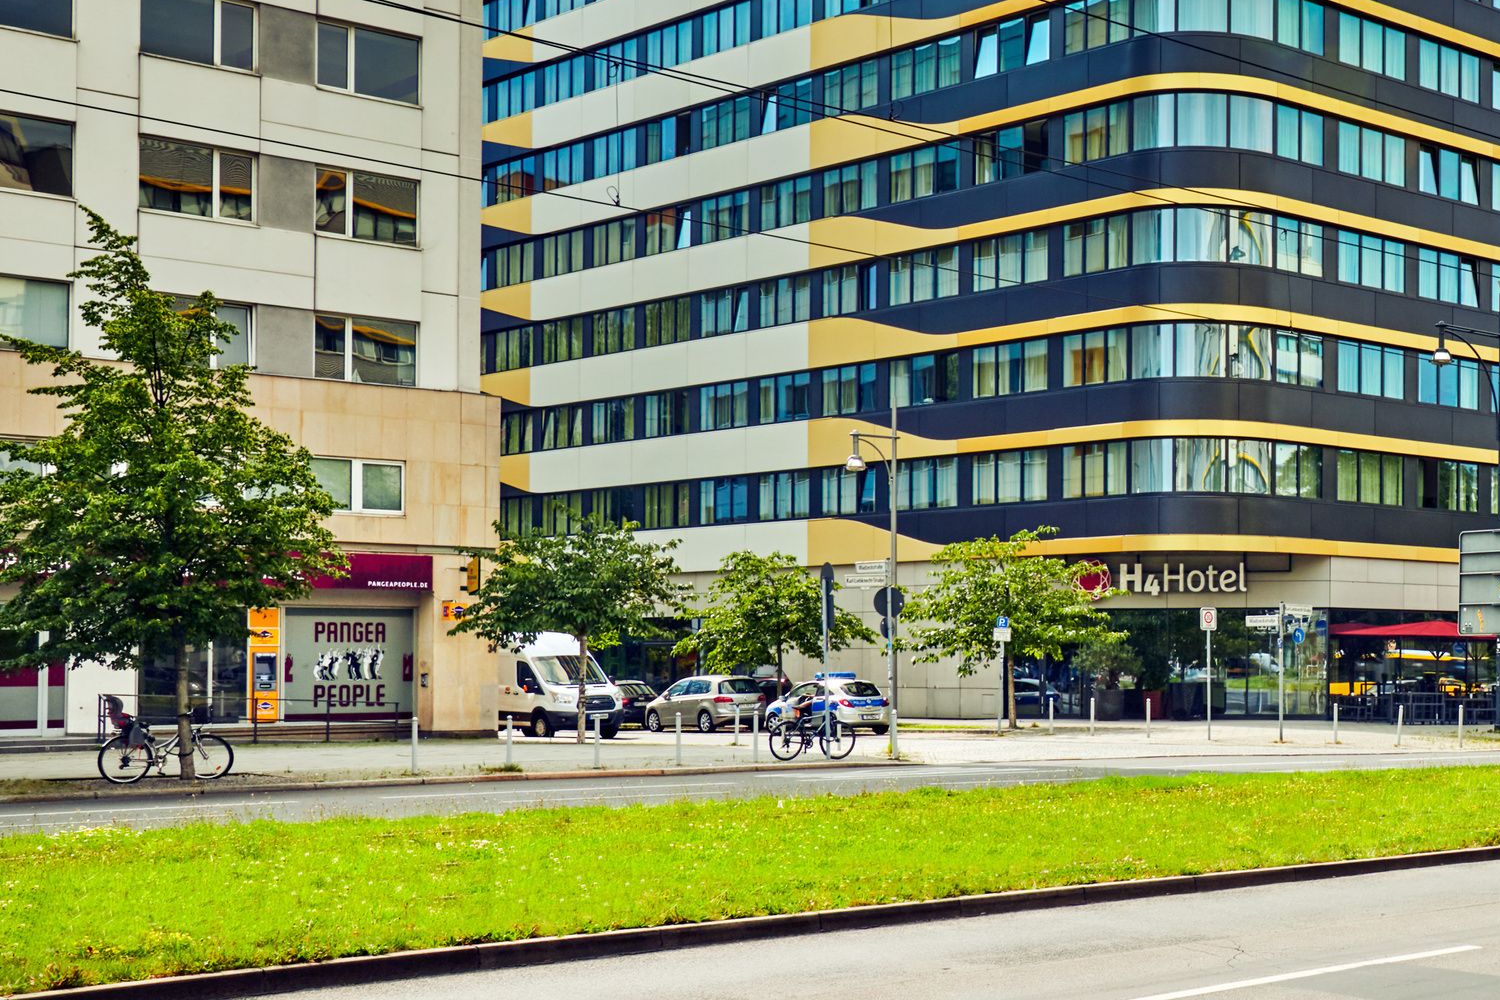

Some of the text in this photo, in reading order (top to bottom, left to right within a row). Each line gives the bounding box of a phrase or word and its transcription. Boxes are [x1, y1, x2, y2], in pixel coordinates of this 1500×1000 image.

[367, 580, 428, 588] PANGEAPEOPLE.DE
[1120, 562, 1247, 596] H4Hotel
[314, 621, 386, 643] PANGEA
[313, 684, 386, 707] PEOPLE
